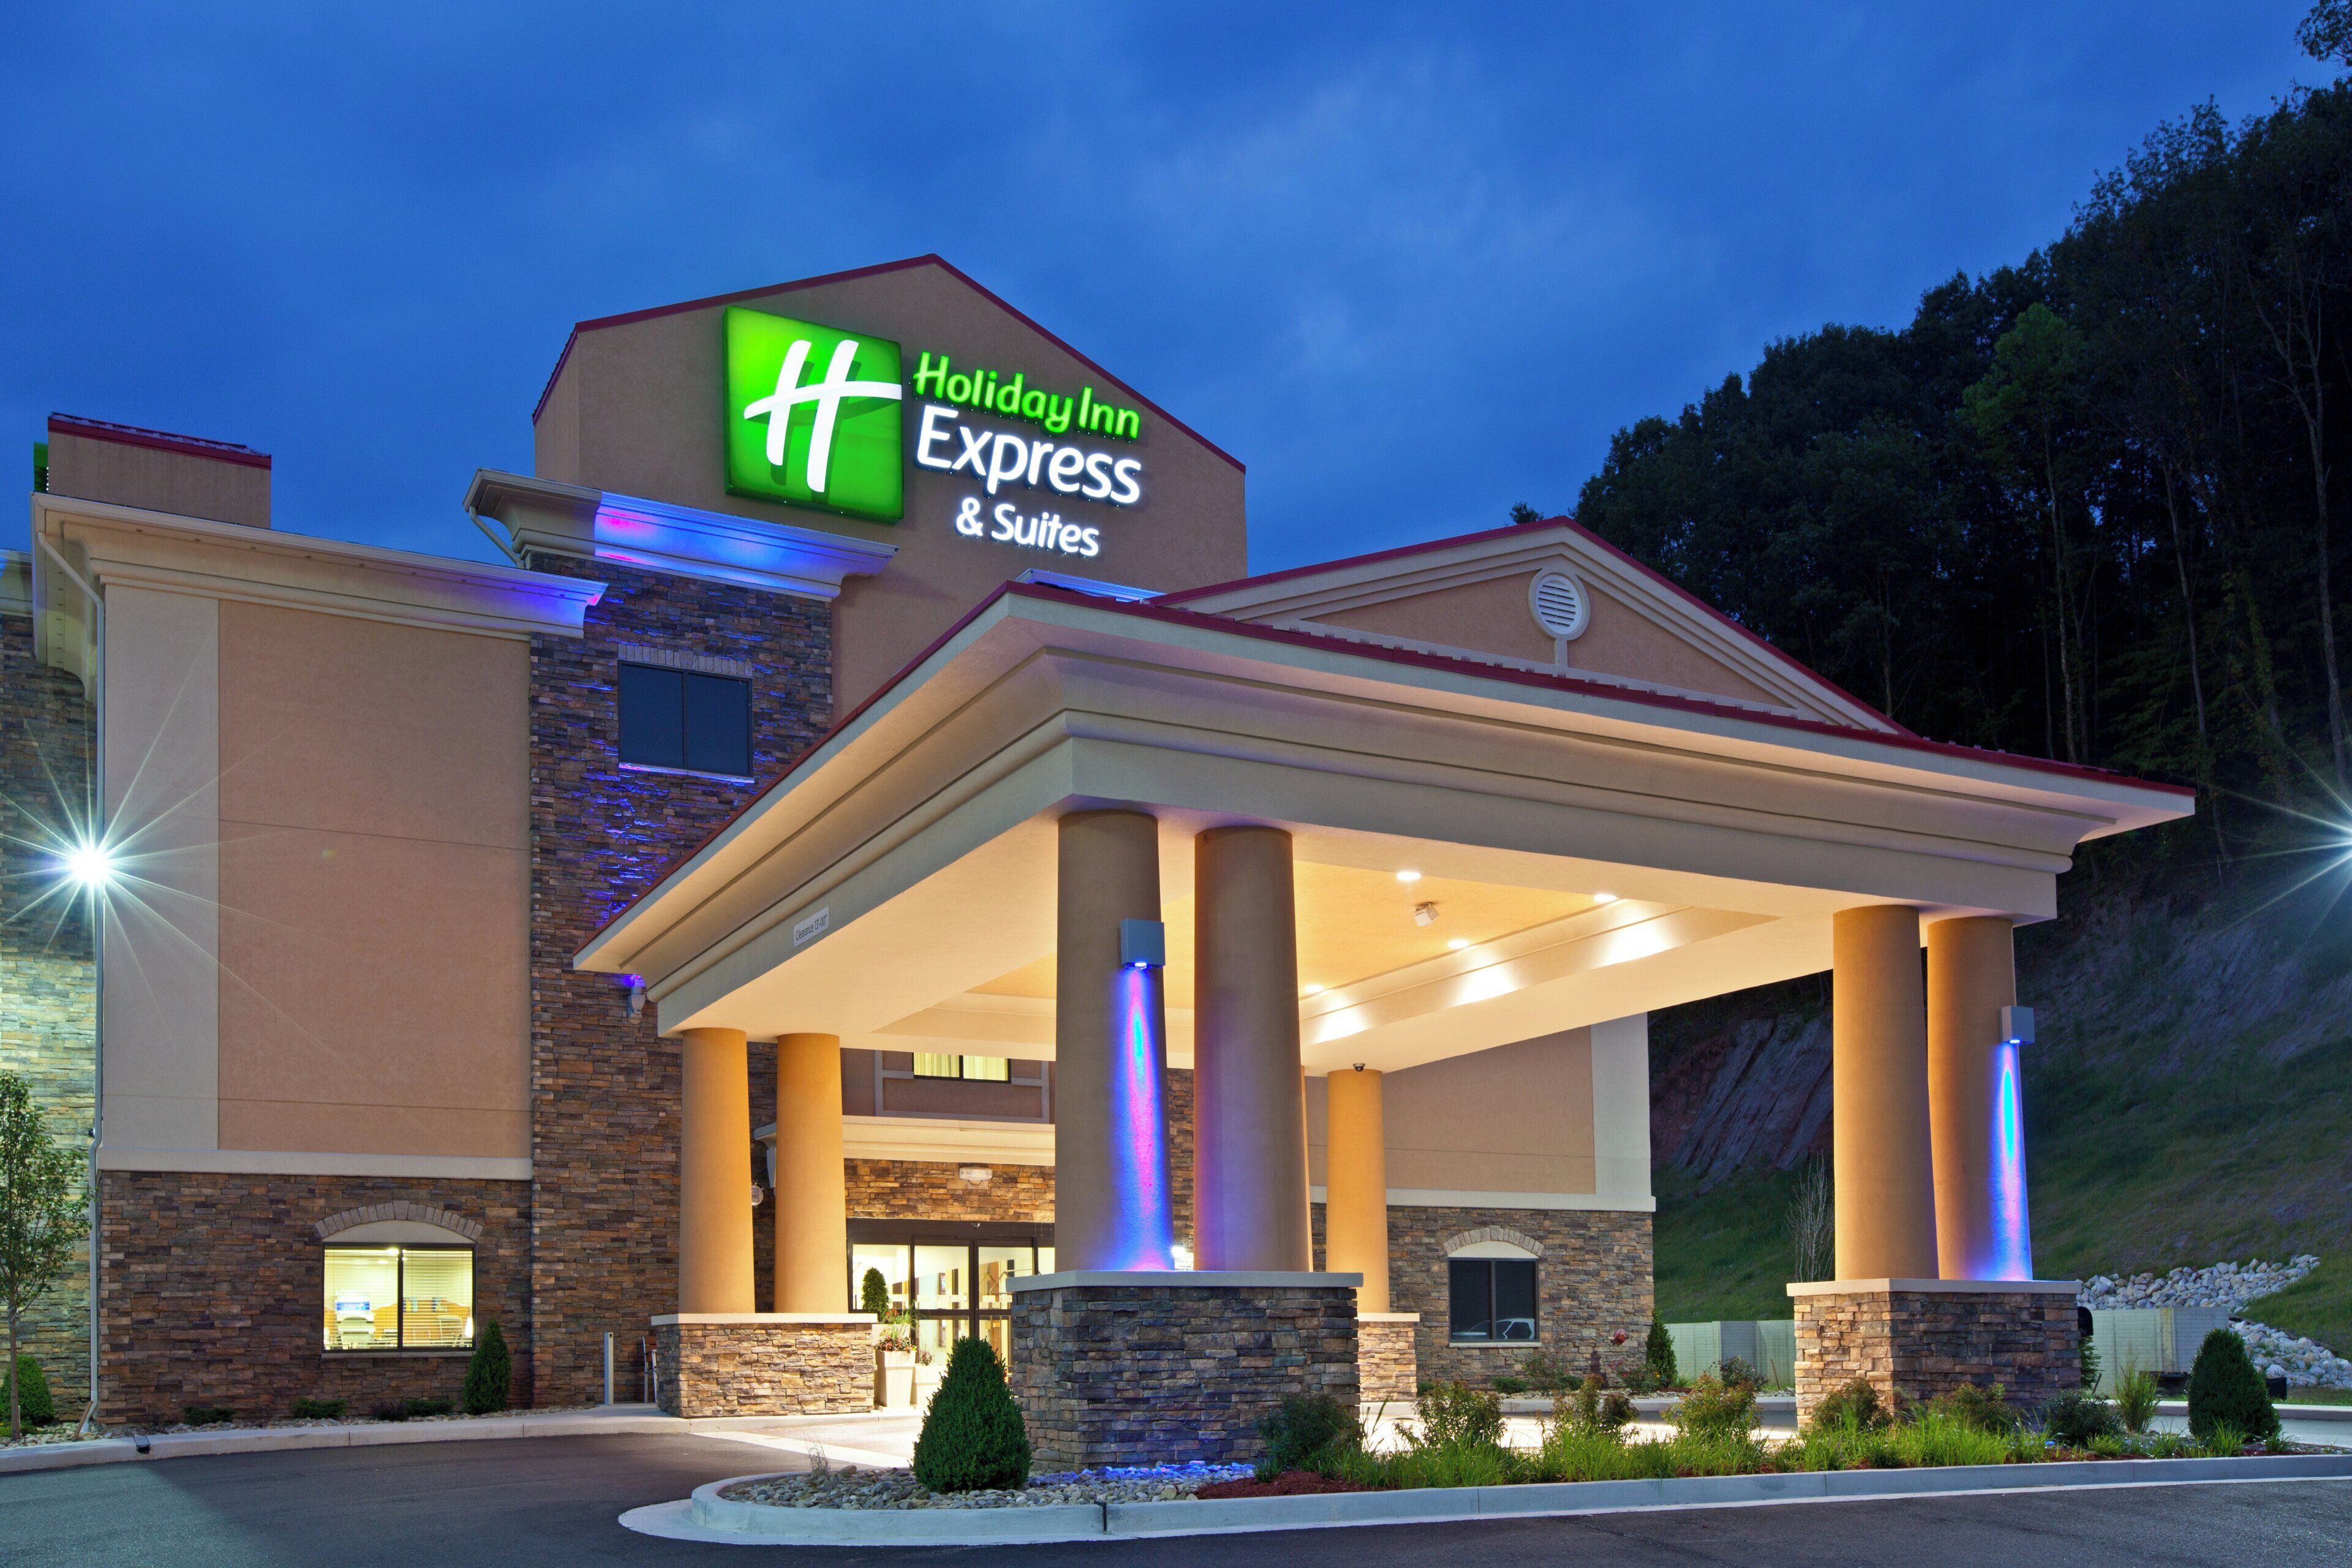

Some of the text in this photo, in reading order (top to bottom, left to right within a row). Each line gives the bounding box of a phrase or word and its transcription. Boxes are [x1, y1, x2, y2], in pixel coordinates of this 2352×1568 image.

[913, 351, 1140, 439] Holiday Inn
[917, 405, 1142, 504] Express
[956, 497, 1099, 557] & Suites
[796, 924, 814, 941] Clearance
